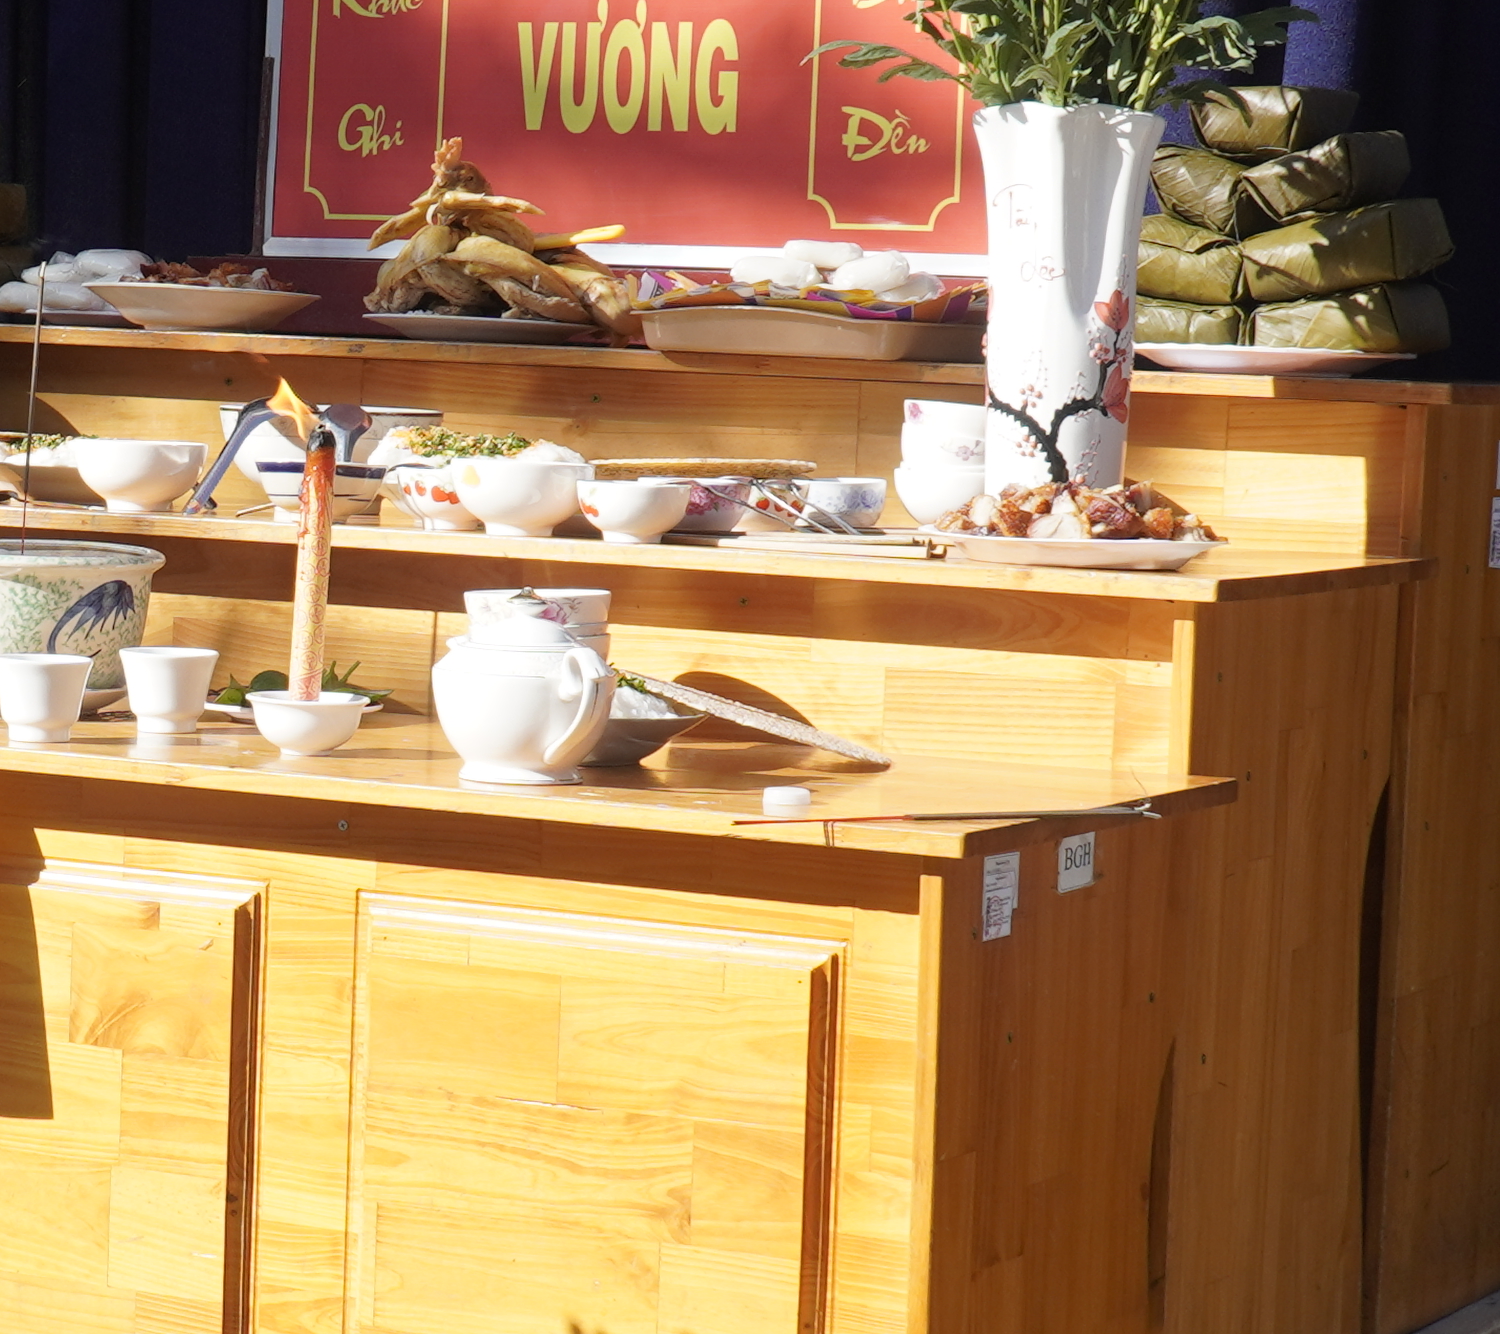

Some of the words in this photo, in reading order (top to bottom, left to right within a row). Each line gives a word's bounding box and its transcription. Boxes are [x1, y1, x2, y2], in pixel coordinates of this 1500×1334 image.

[337, 103, 405, 160] Ghi
[840, 105, 932, 163] Đền
[1064, 841, 1092, 872] BGH
